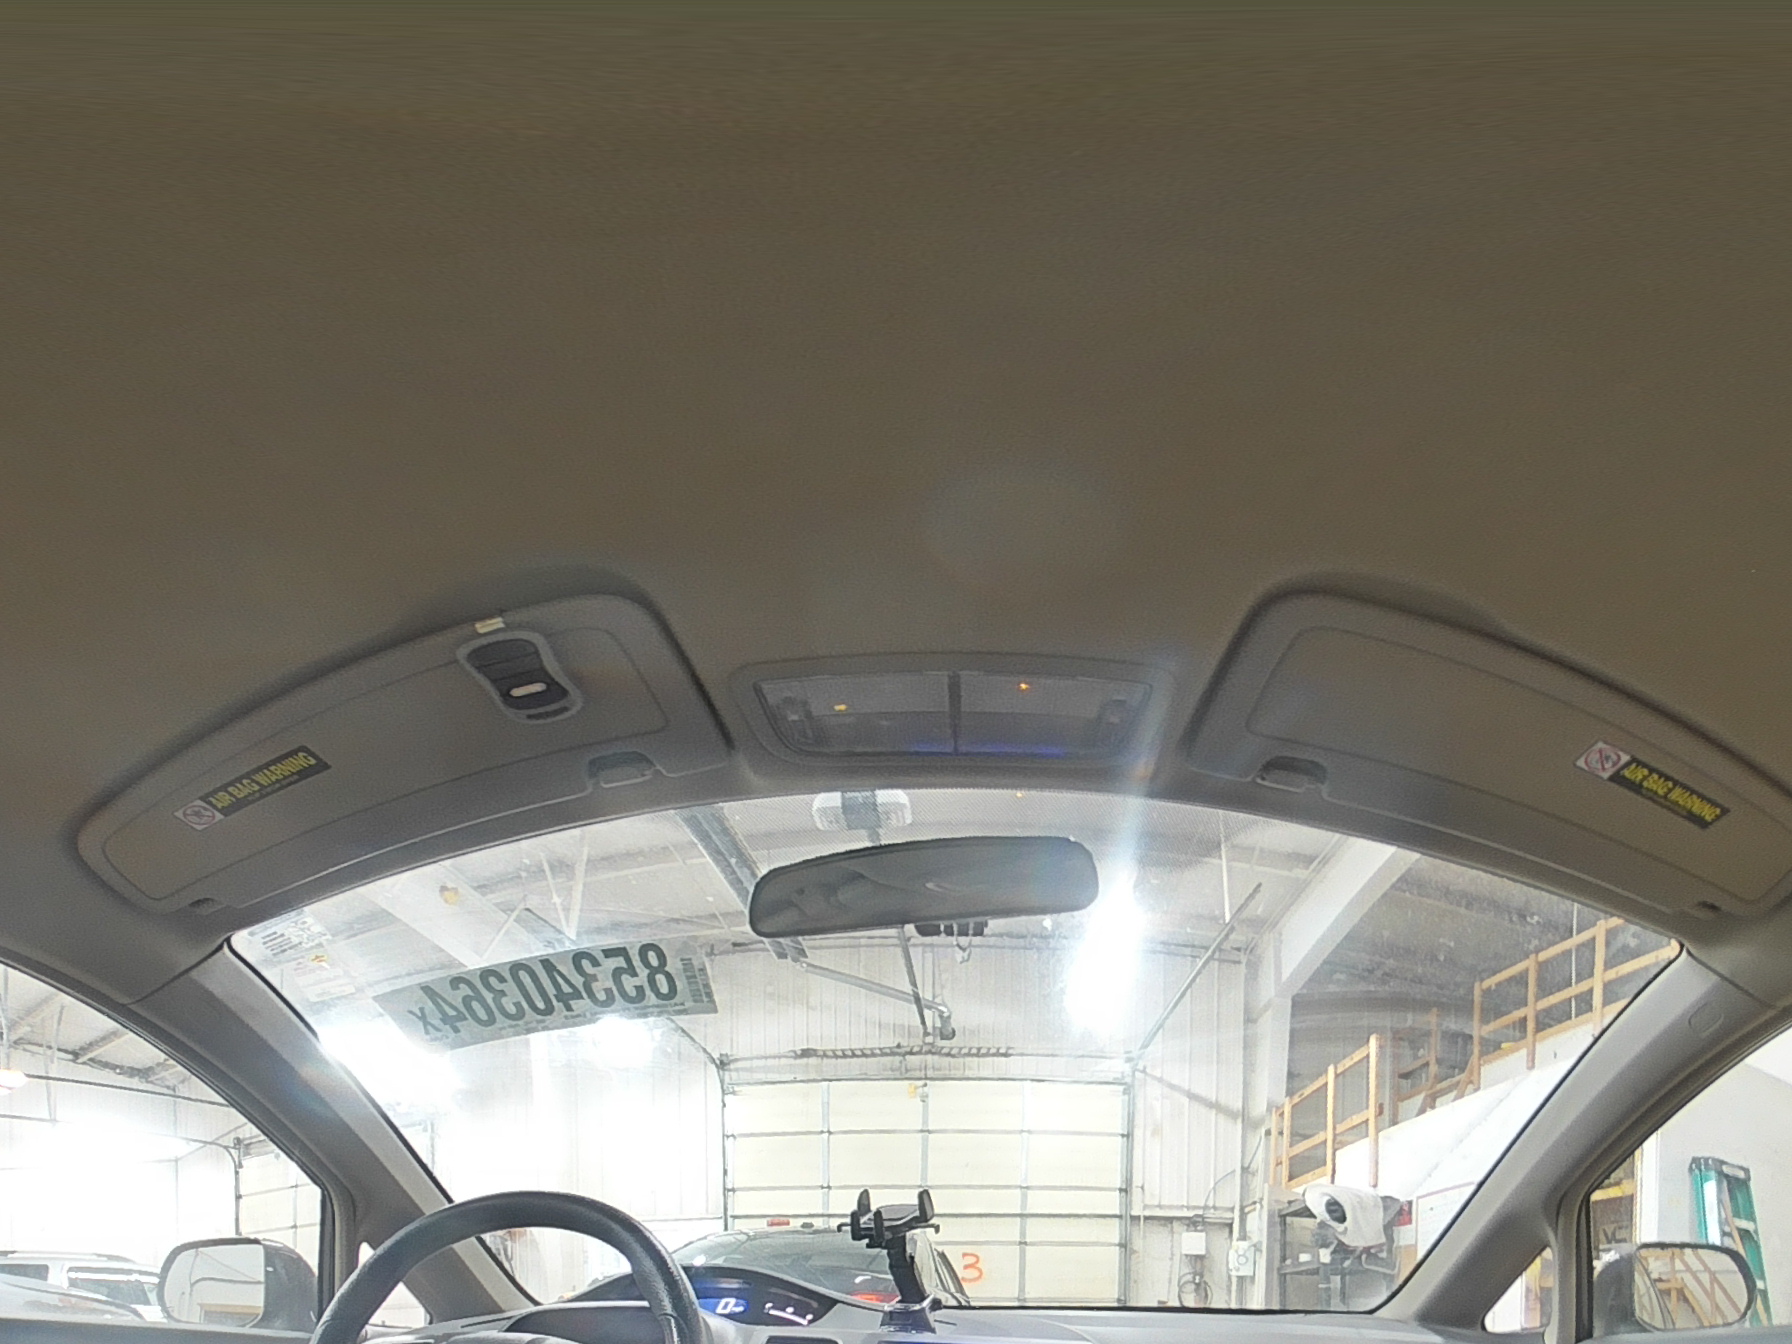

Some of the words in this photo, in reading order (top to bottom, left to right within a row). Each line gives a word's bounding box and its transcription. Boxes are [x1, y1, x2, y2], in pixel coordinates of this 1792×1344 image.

[209, 791, 236, 809] AIR
[227, 779, 260, 798] BAG
[252, 752, 317, 786] WARNING
[1620, 763, 1649, 784] AIR
[1642, 773, 1673, 796] BAG
[961, 1252, 983, 1283] 3
